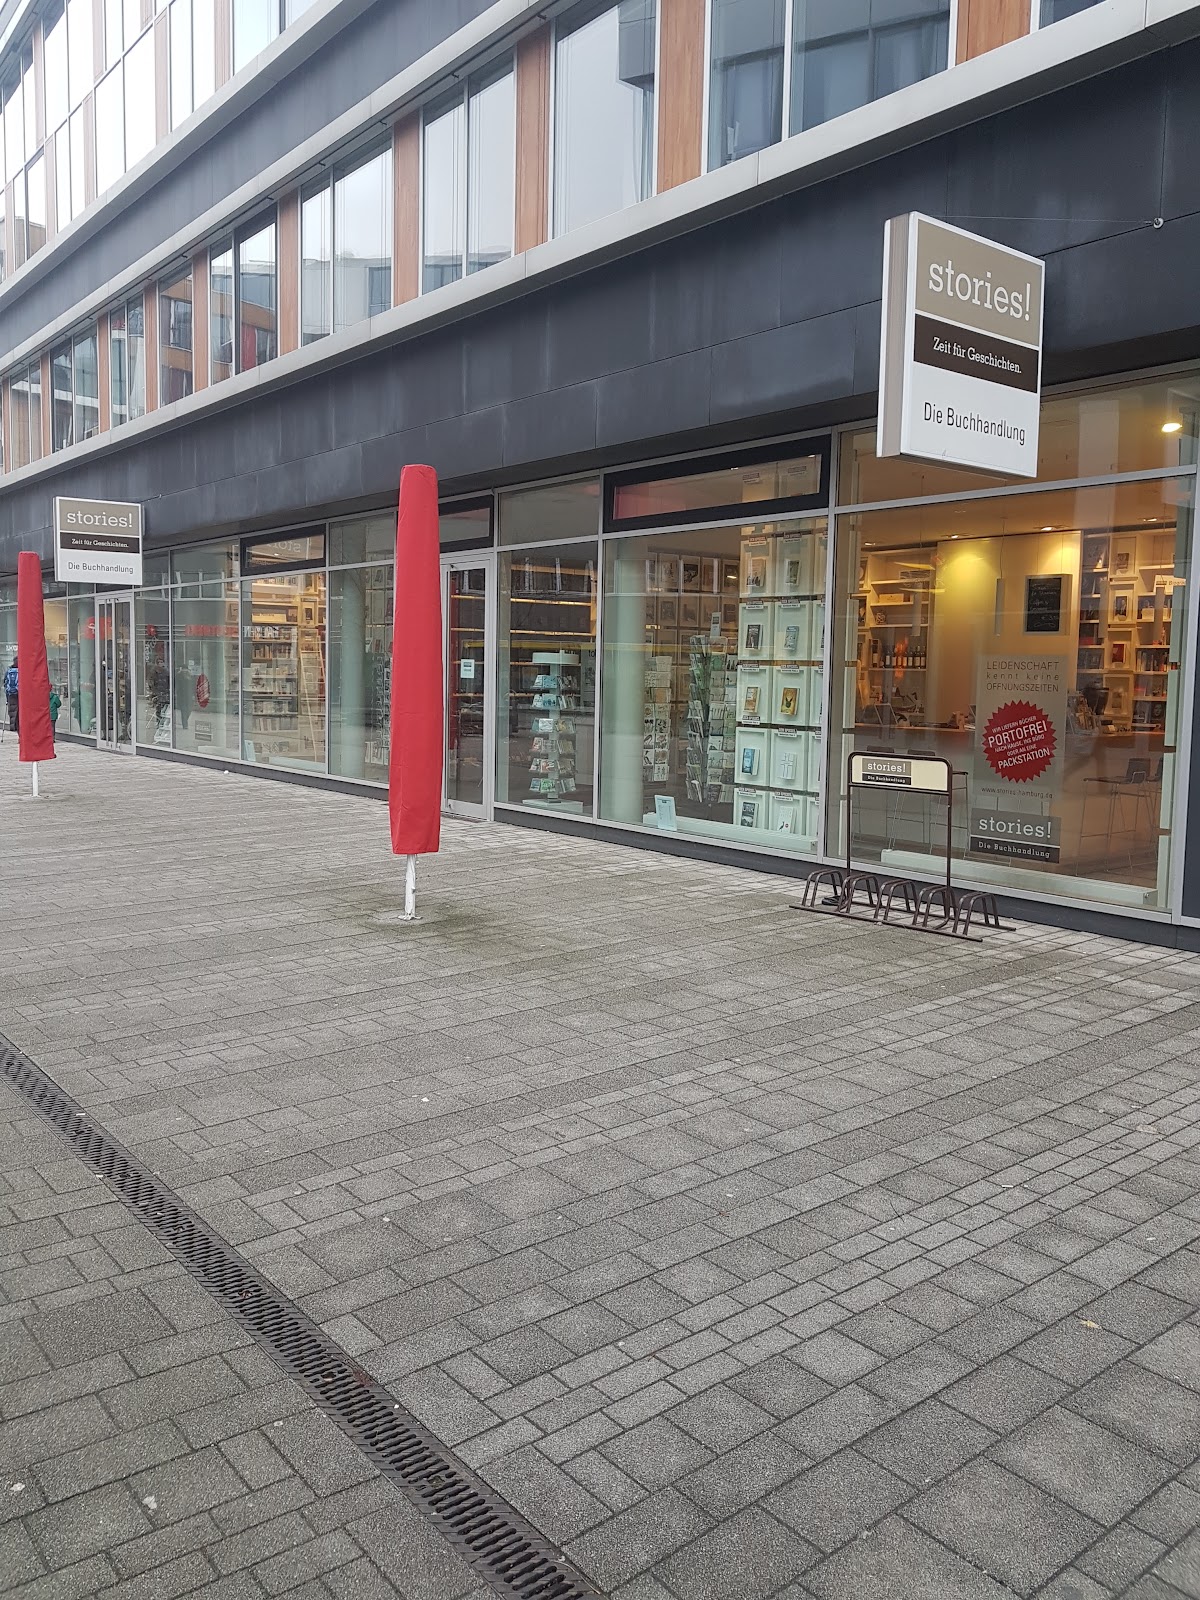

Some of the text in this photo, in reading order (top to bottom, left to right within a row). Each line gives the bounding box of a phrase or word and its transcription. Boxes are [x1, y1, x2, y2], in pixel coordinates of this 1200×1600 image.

[928, 259, 1031, 322] stories!
[933, 337, 1022, 374] Zeit für Geschichten.
[923, 402, 1026, 446] Die Buchhandlung
[67, 510, 133, 528] stories!
[93, 540, 129, 548] Geschichten.
[68, 562, 134, 575] Die Buchhandlung
[986, 660, 1060, 671] LEIDENSCHAFT
[986, 672, 1060, 681] kennt keine
[988, 720, 1048, 748] PORTOFREI
[867, 761, 906, 773] stories!
[998, 747, 1050, 770] PACKSTATION
[876, 776, 906, 784] Buchhandlung
[978, 816, 1052, 838] stories!
[978, 842, 1050, 859] Die Buchhandlung
